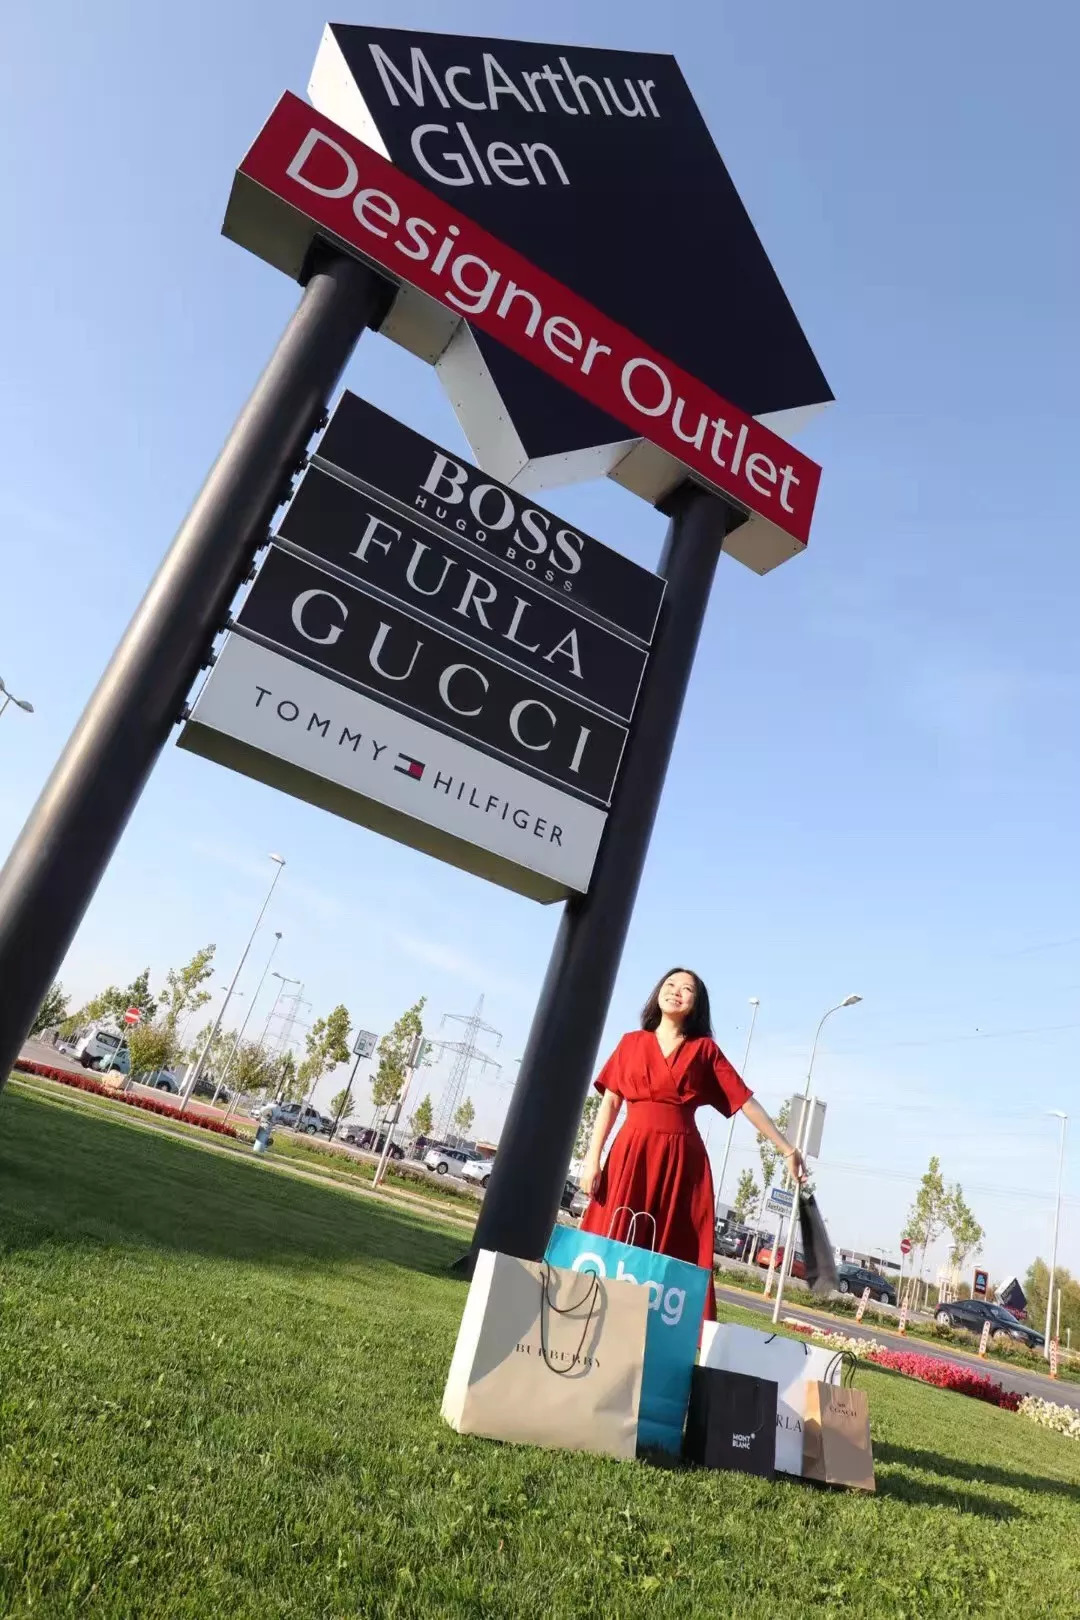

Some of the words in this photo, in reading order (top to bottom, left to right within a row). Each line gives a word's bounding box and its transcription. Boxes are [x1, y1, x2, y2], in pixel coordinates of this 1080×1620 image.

[368, 43, 661, 118] McArthur
[410, 121, 571, 187] Glen
[285, 127, 612, 376] Designer
[620, 357, 801, 514] Outlet
[415, 494, 487, 542] HUGO
[505, 546, 573, 593] BOSS
[419, 450, 585, 575] BOSS
[349, 512, 585, 679] FURLA
[291, 588, 592, 773] GUCCI
[255, 685, 389, 762] TOMMY
[433, 771, 563, 846] HILFIGER
[732, 1433, 751, 1442] MONT
[732, 1440, 751, 1450] BLANC
[776, 1413, 802, 1433] RLA
